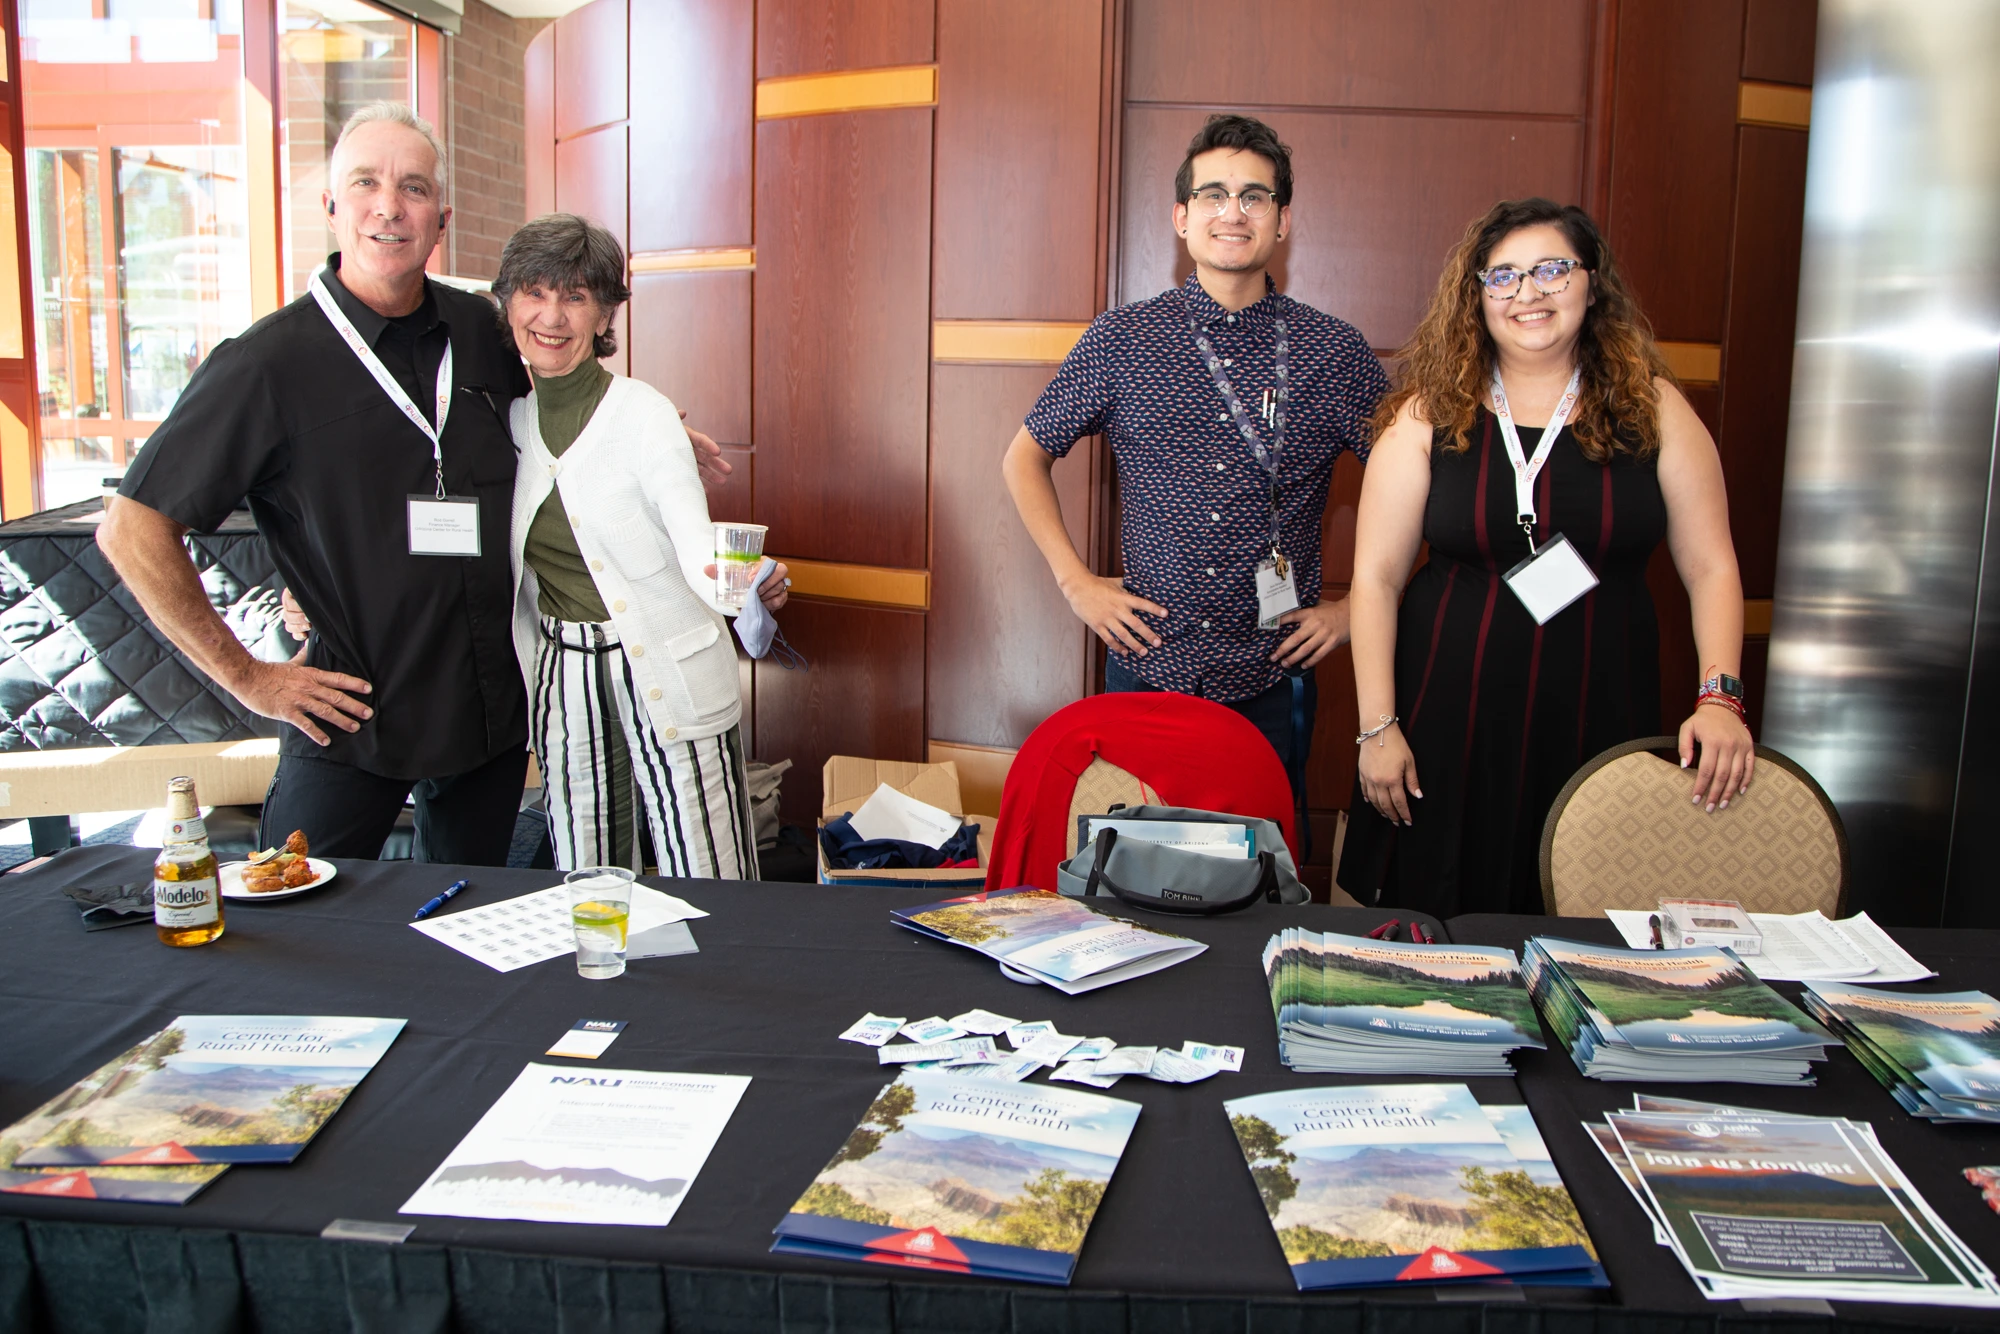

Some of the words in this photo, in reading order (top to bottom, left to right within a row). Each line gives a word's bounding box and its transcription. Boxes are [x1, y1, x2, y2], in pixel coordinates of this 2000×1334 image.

[157, 886, 204, 903] Modelo
[1164, 891, 1180, 900] TOM
[1103, 936, 1147, 949] Center
[1082, 946, 1104, 956] for
[1354, 947, 1391, 955] Center
[1451, 954, 1488, 962] Health
[1577, 953, 1613, 963] Center
[1667, 959, 1704, 967] Health
[1847, 994, 1883, 1004] Center
[1904, 1002, 1934, 1010] Rural
[222, 1031, 293, 1041] Center
[296, 1032, 328, 1042] for
[197, 1041, 256, 1050] Rural
[261, 1042, 332, 1053] Health
[550, 1076, 623, 1087] NAU
[662, 1081, 717, 1089] COUNTRY
[953, 1093, 1025, 1110] Center
[1031, 1103, 1062, 1117] for
[1303, 1106, 1375, 1118] Center
[1383, 1104, 1412, 1115] for
[930, 1101, 990, 1117] Rural
[997, 1110, 1070, 1131] Health
[1293, 1118, 1354, 1132] Rural
[1361, 1116, 1437, 1128] Health
[1709, 1159, 1743, 1169] us
[1749, 1159, 1855, 1175] tonight
